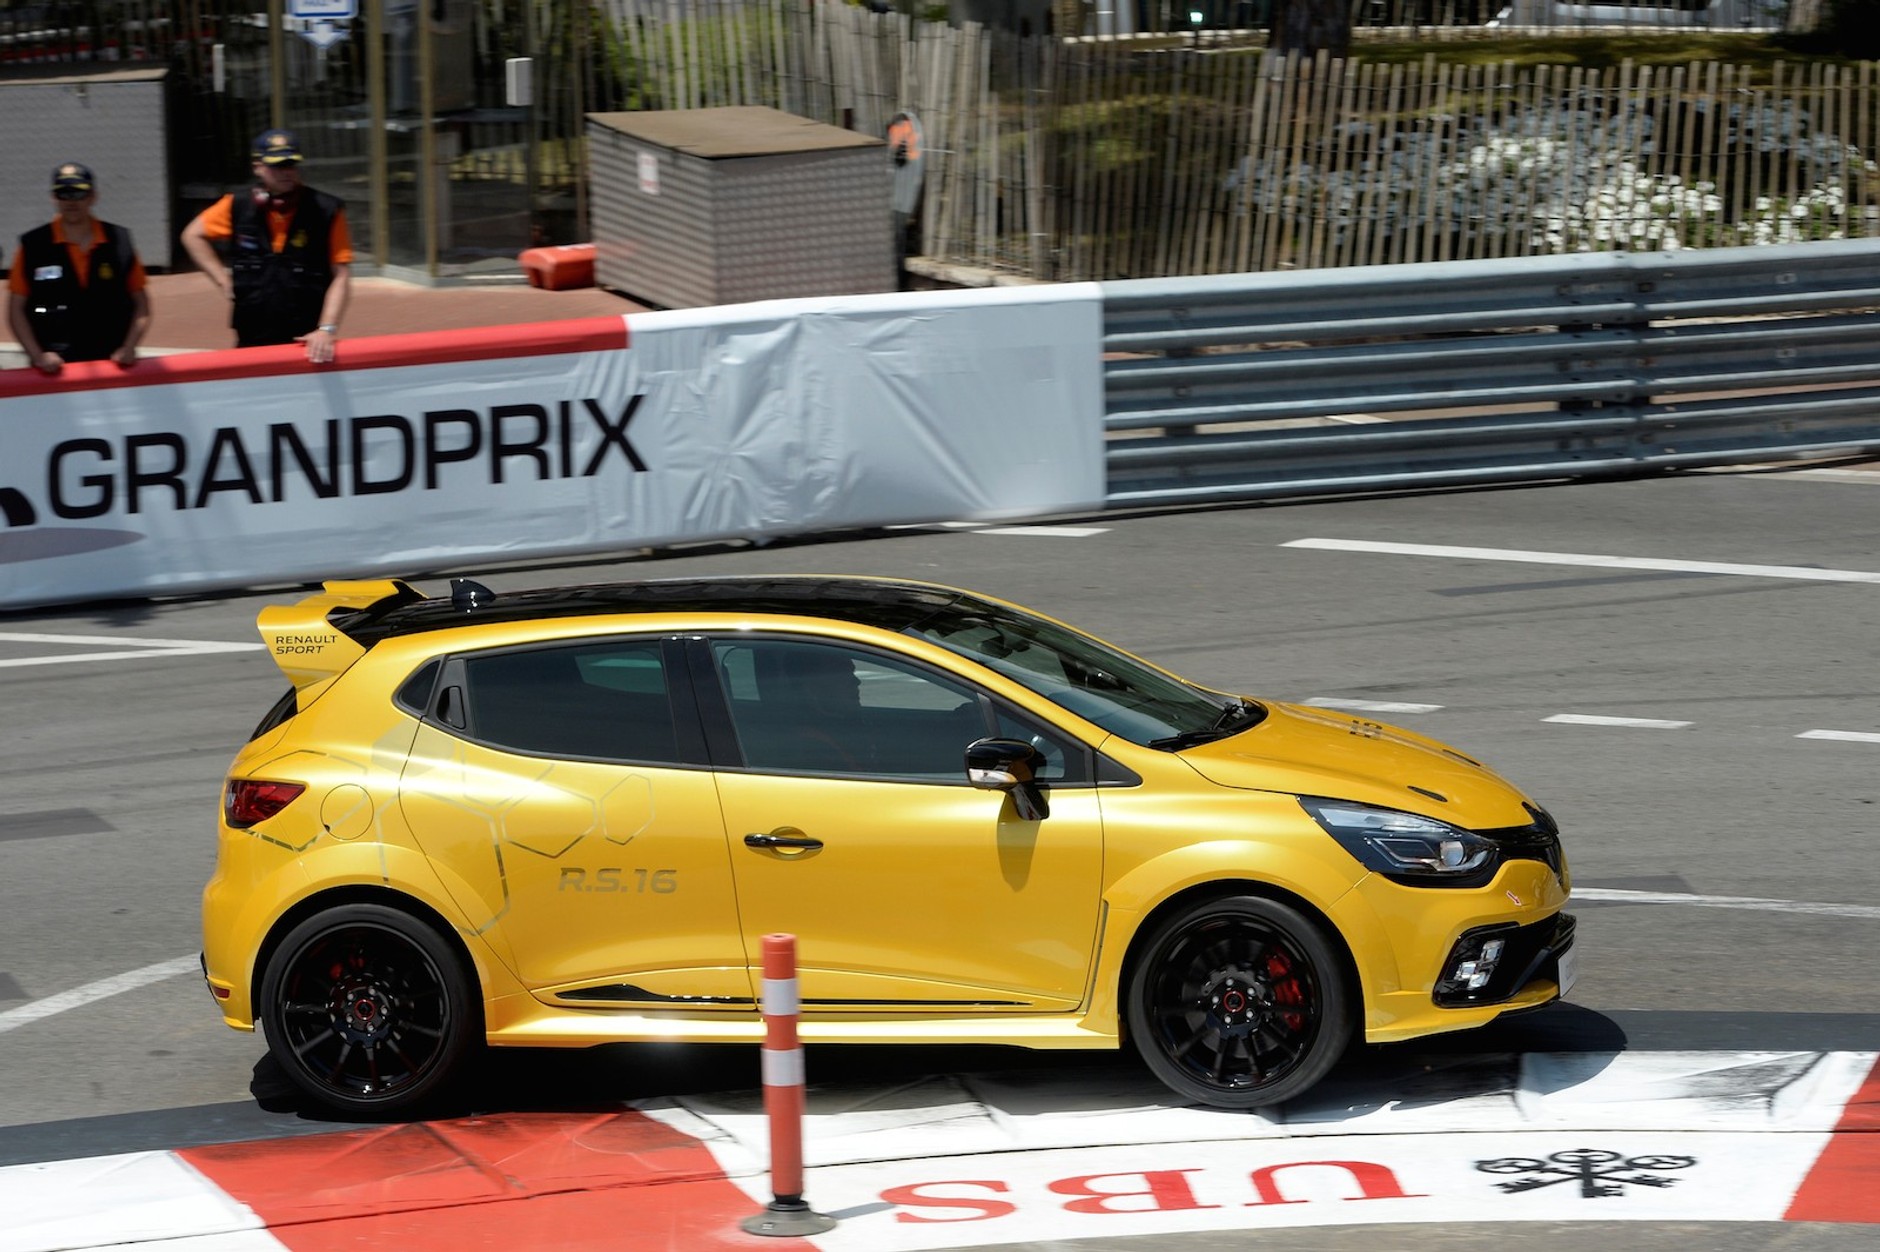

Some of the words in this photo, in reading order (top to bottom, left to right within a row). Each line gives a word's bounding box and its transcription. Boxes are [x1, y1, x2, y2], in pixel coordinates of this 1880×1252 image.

[48, 394, 649, 519] GRANDPRIX
[275, 635, 338, 644] RENAULT
[275, 645, 324, 655] SPORT
[558, 867, 677, 894] R.S.16
[879, 1160, 1430, 1223] UBS
